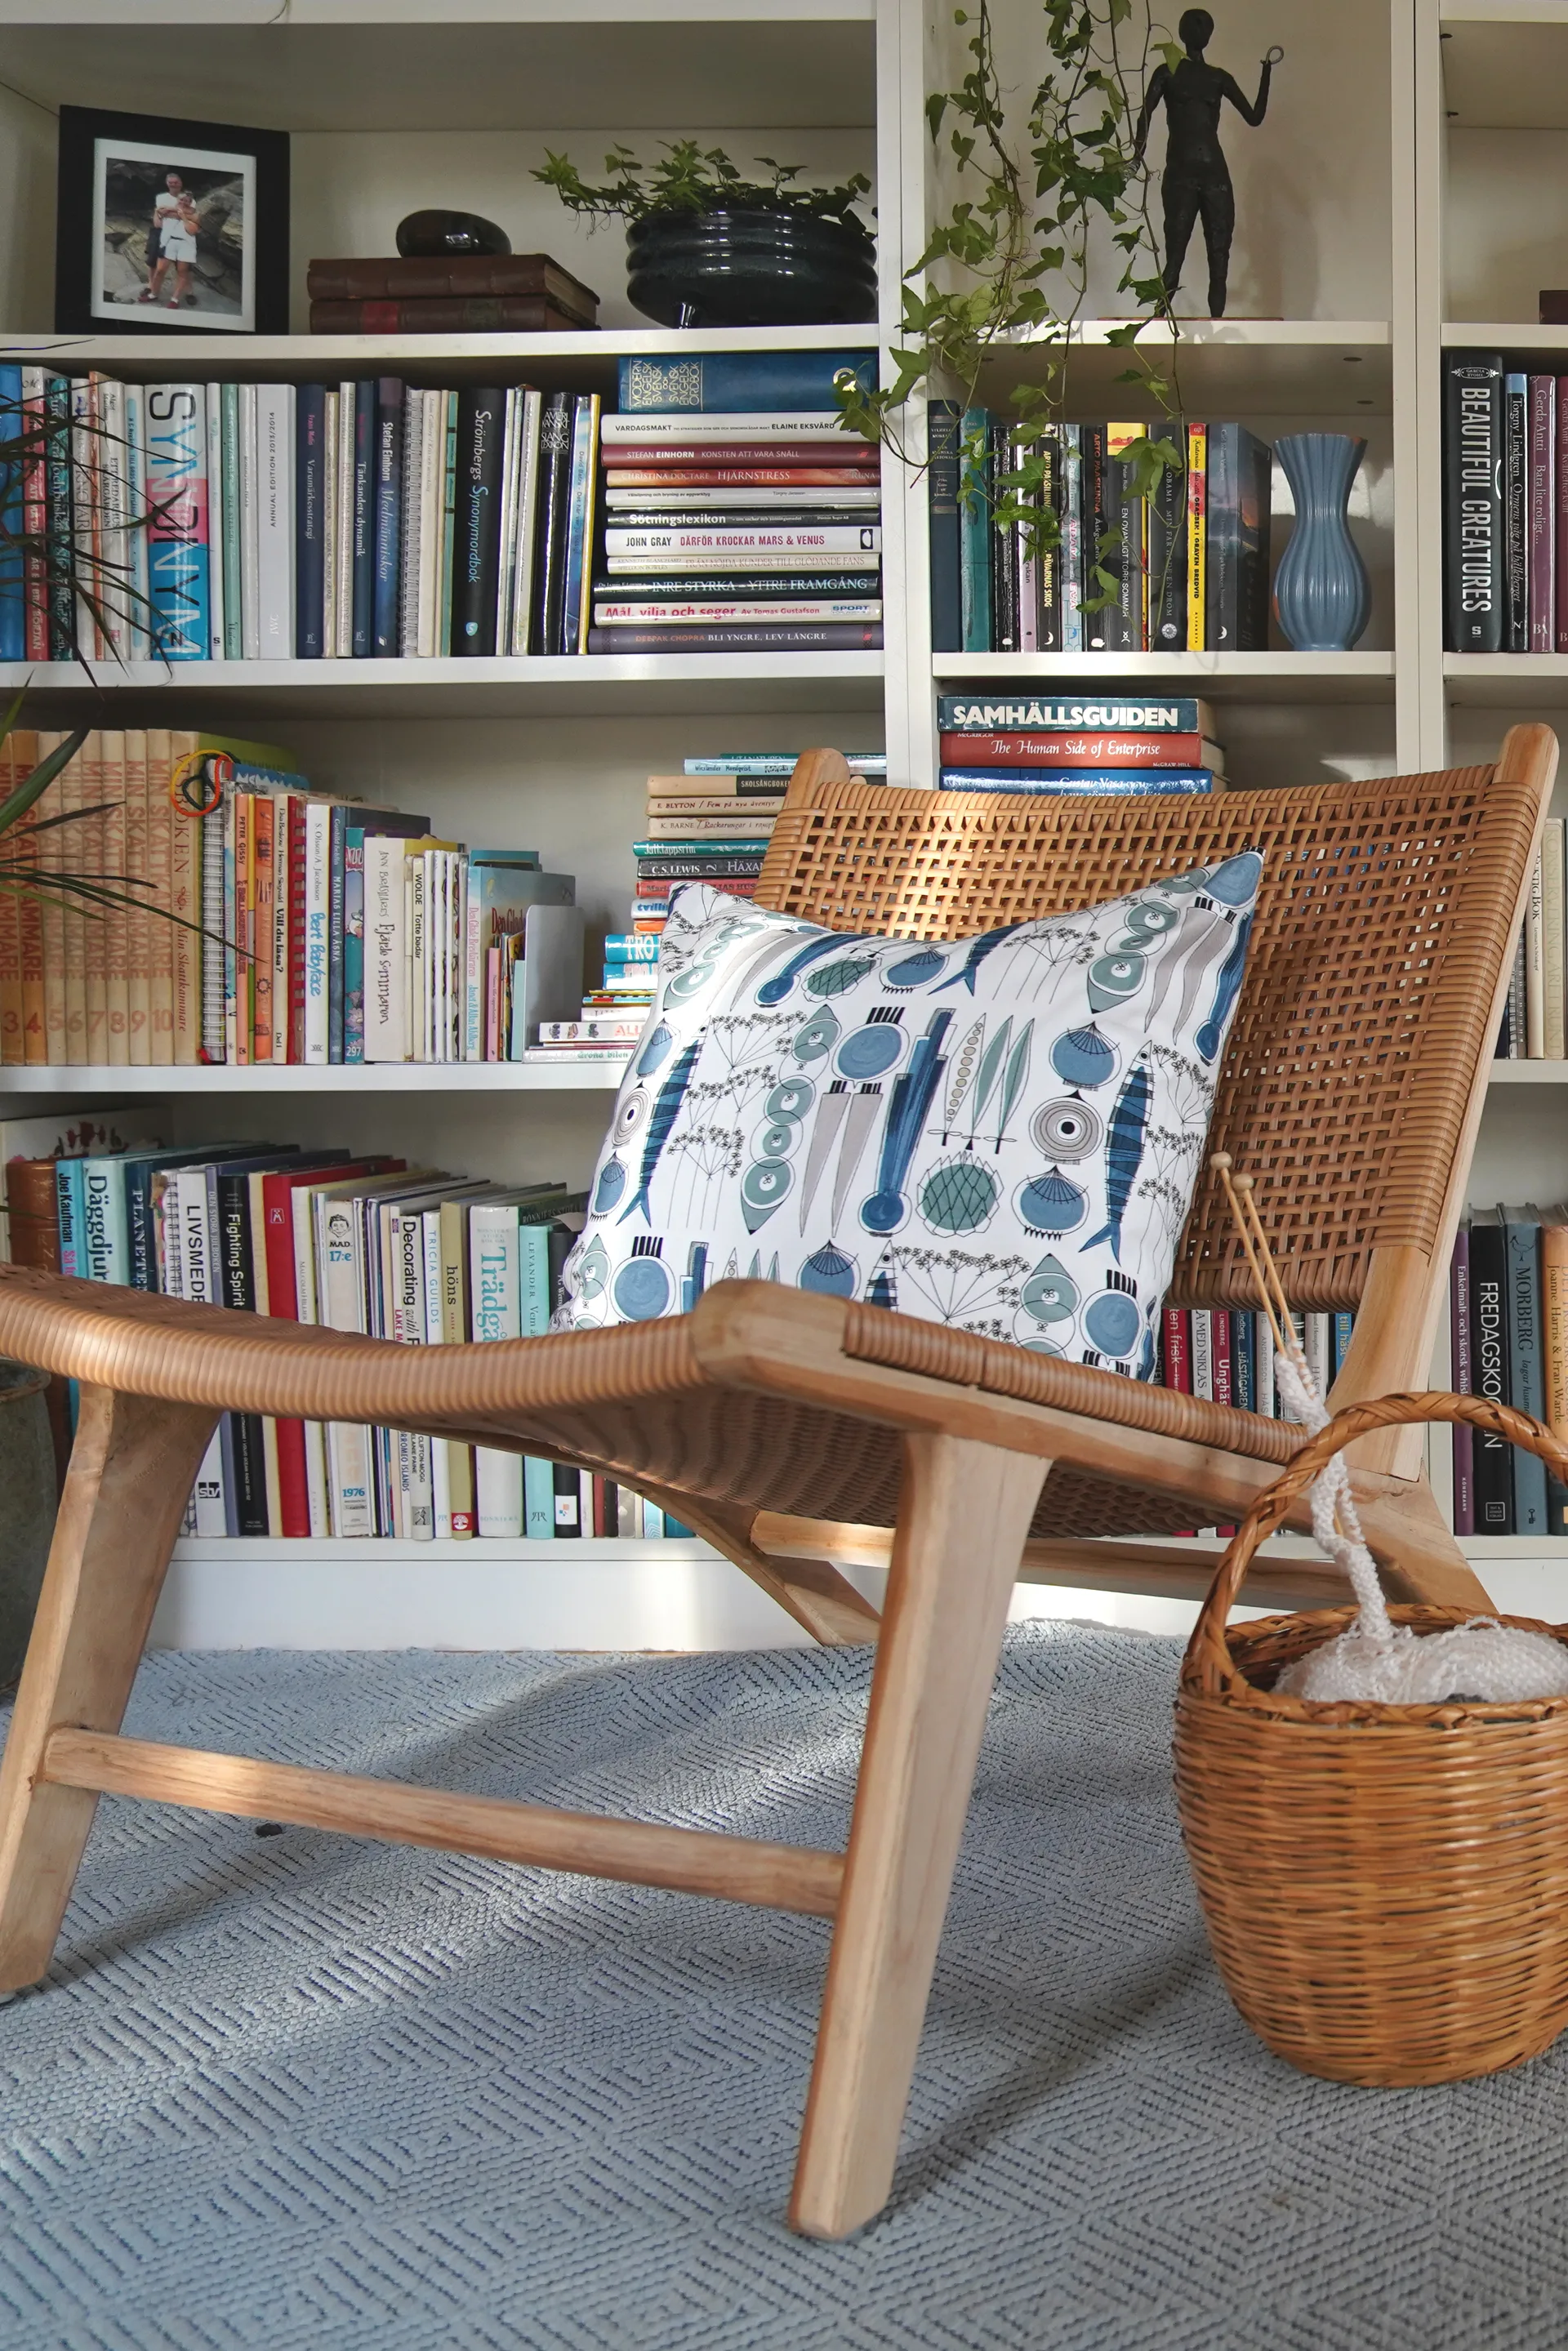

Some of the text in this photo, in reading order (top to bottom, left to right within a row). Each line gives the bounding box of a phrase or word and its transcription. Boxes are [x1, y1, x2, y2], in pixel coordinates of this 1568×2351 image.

[632, 360, 642, 407] MODERN
[642, 362, 653, 406] ENGELSK
[653, 366, 662, 402] SVENSK
[669, 366, 679, 402] SVENSK
[679, 362, 689, 405] ENGELSK
[689, 362, 699, 405] ORDBOK
[776, 450, 800, 458] SNÄLL
[1509, 398, 1523, 519] Torgny Lindgren Ormens
[1535, 390, 1547, 505] Gerda Antti Bara lite
[717, 470, 791, 483] HJÄRNSTRESS
[305, 460, 316, 541] Varumärkesstrategi
[354, 461, 368, 558] Tänkandets dynamik
[378, 421, 394, 582] Stefan Einhorn Medmänniskor
[468, 410, 492, 583] Strömbergs Synonymordbok
[1121, 508, 1129, 519] EN
[1461, 387, 1491, 612] BEAUTIFUL CREATURES
[629, 513, 727, 527] Sötningslexikon
[626, 535, 825, 546] JOHN GRAY DÄRFÖR KROCKAR MARS & VENUS
[1069, 519, 1077, 561] ADAM
[1121, 520, 1129, 557] OVANLIGT
[738, 556, 865, 568] KUNDER TILL GLÖDANDE FANS
[1121, 559, 1129, 581] TORR
[653, 581, 683, 593] INRE
[684, 581, 737, 593] STYRKA
[749, 580, 787, 590] YTTRE
[790, 577, 867, 590] FRAMGÅNG
[1044, 553, 1054, 608] RÄVARNAS SKOG
[1069, 581, 1077, 611] EVA
[640, 607, 666, 621] vilja
[671, 607, 695, 617] och
[700, 608, 737, 620] seger
[1121, 582, 1129, 618] SOMMAR
[1166, 591, 1174, 617] DRÖM
[787, 632, 827, 640] LÄNGRE
[953, 701, 1178, 727] SAMHÄLLSGUIDEN
[991, 740, 1160, 758] The Human Side of Enterprise
[237, 843, 247, 866] GISSY
[670, 865, 701, 873] LEWIS
[313, 867, 323, 902] Jacobsson
[332, 875, 341, 962] MARIAS LILLA ÅSNA
[415, 873, 423, 960] WOLDE Totte badar
[469, 906, 479, 919] Den
[1531, 896, 1542, 920] BOK
[275, 908, 285, 973] Vill du läsa?
[306, 912, 327, 997] Bert Babyface
[176, 925, 190, 1032] Min Skattkammare
[3, 1011, 20, 1033] 3
[24, 1013, 42, 1035] 4
[69, 1011, 83, 1033] 6
[89, 1011, 107, 1034] 7
[110, 1011, 126, 1035] 8
[131, 1010, 147, 1033] 9
[151, 1010, 173, 1033] 10
[346, 1046, 362, 1057] 297
[58, 1173, 74, 1243] Joe Kaufman
[86, 1175, 114, 1280] Däggdjur
[210, 1209, 220, 1273] STORA JULBOKEN
[226, 1214, 243, 1267] Fighting
[329, 1250, 352, 1262] 17:e
[402, 1220, 419, 1305] Decorating
[428, 1229, 438, 1271] TRICIA
[229, 1271, 246, 1307] Spirit
[446, 1264, 459, 1305] höns
[528, 1242, 539, 1327] LEVANDER Vem
[394, 1308, 403, 1331] LAKE
[405, 1307, 421, 1334] with
[1339, 1316, 1350, 1331] till
[1515, 1267, 1534, 1383] MORBERG lagar
[1169, 1334, 1183, 1365] frisk
[1196, 1323, 1208, 1389] MED NIKLAS
[1458, 1318, 1468, 1367] och skotsk
[1546, 1264, 1565, 1424] Joanne Harris & Fran Warde
[342, 1488, 365, 1498] 1976
[401, 1463, 410, 1492] ISLANDS
